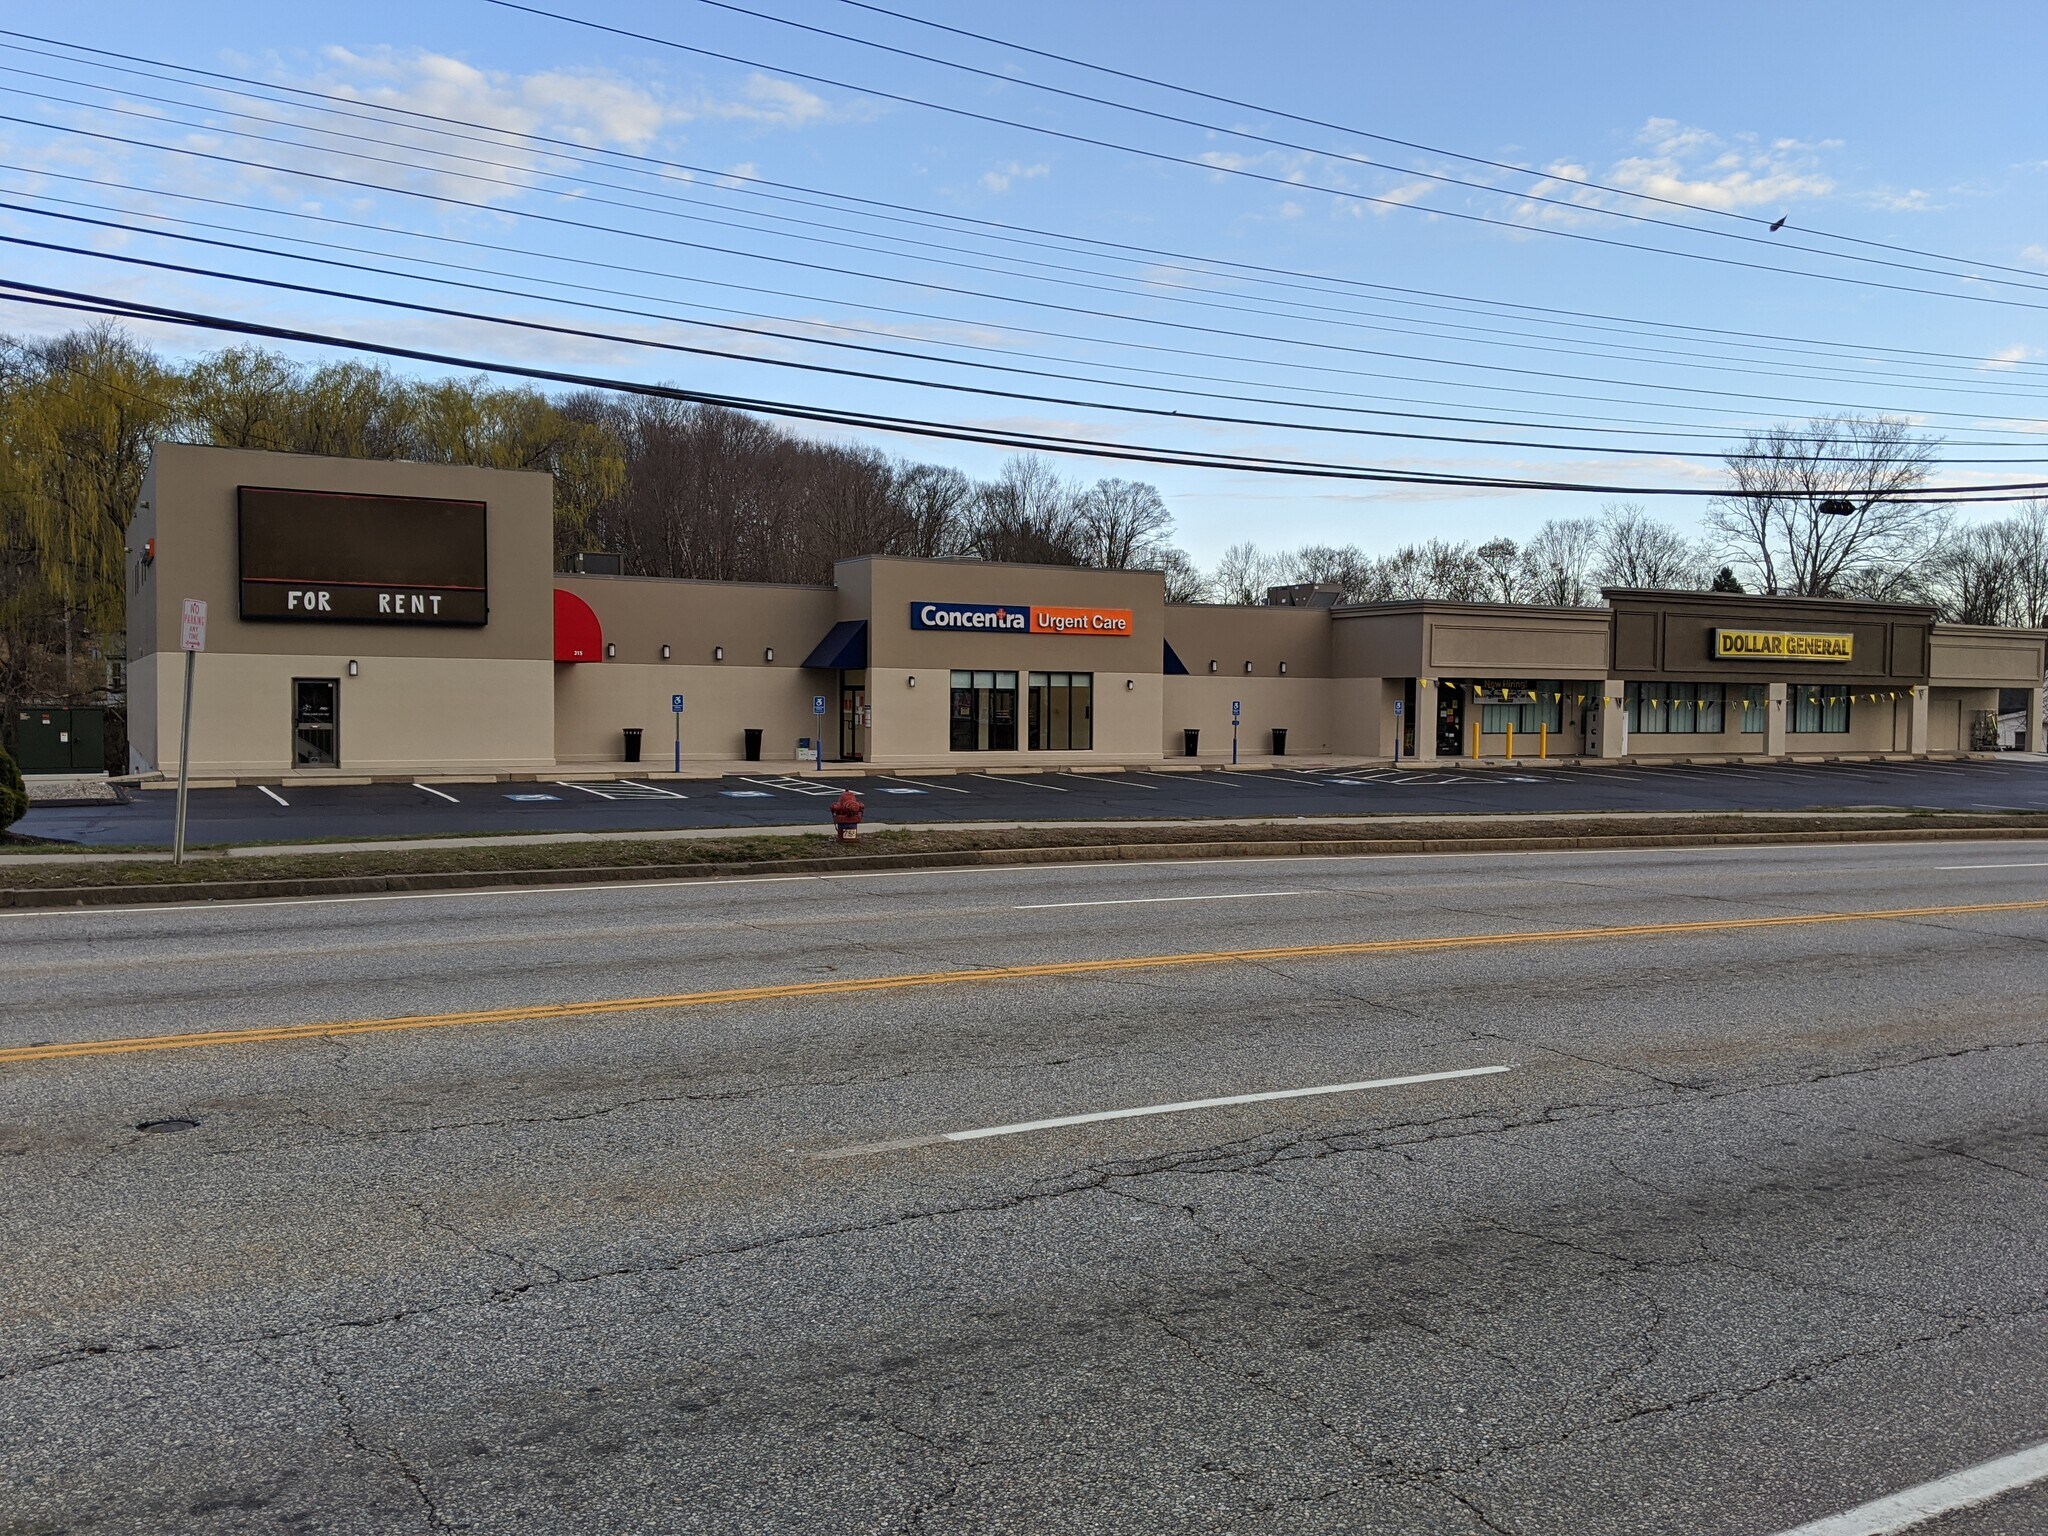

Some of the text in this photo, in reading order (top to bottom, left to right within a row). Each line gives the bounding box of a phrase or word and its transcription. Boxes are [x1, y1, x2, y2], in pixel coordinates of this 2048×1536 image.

[190, 603, 200, 615] NO
[287, 591, 442, 615] FOR RENT
[184, 613, 205, 626] PARKING
[920, 605, 1025, 629] Concentra
[1038, 612, 1127, 631] Urgent Care
[1722, 634, 1849, 656] DOLLAR GENERAL
